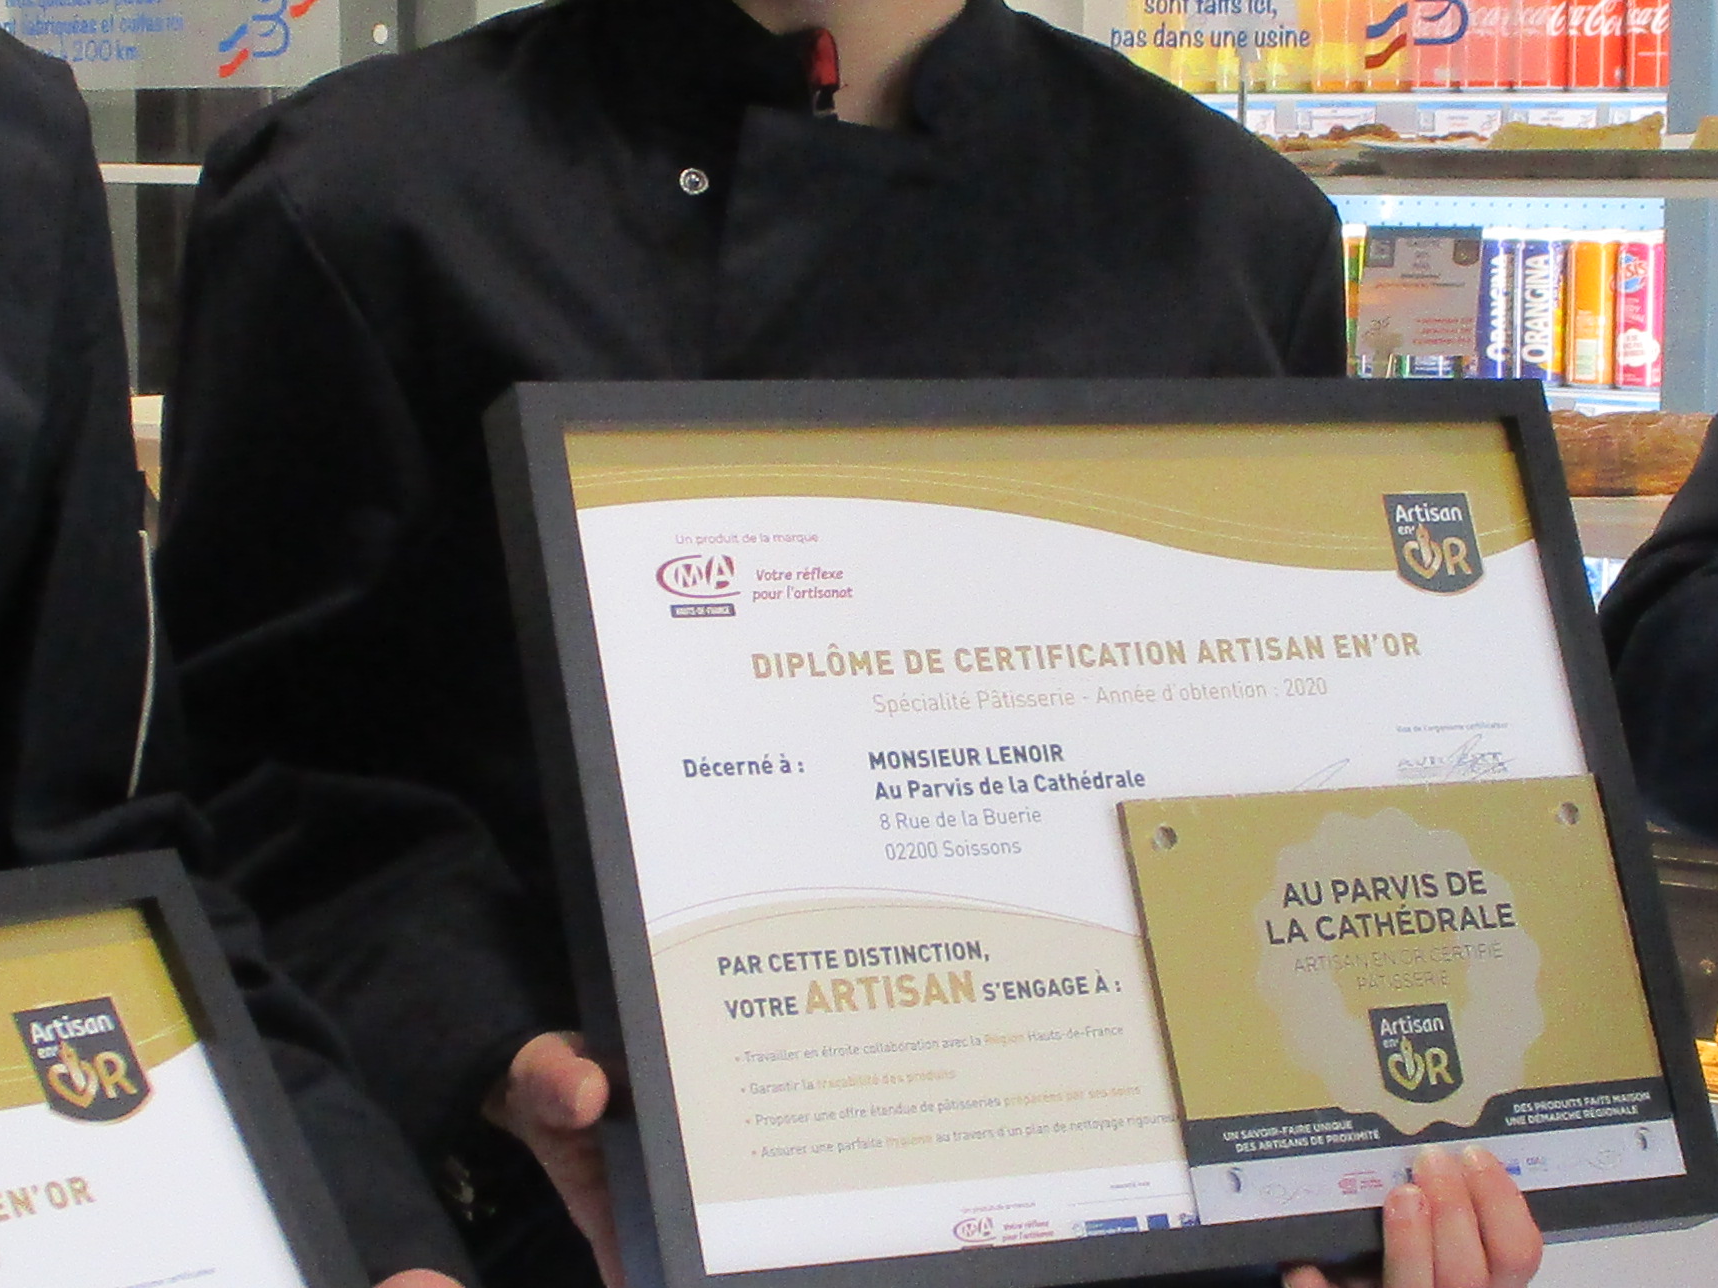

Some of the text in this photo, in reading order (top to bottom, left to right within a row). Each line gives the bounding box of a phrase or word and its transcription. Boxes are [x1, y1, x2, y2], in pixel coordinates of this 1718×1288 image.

[1110, 22, 1312, 49] pas dans une usine
[72, 39, 112, 62] 200
[1521, 253, 1552, 364] ORANGINA
[1394, 503, 1463, 524] Artisan
[755, 566, 843, 581] Votre réflexe
[751, 632, 1419, 679] DIPLÔME DE CERTIFICATION ARTISAN EN'OR
[871, 690, 971, 717] Spécialité
[975, 688, 1075, 709] Pâtisserie
[1096, 684, 1156, 704] Année
[1283, 676, 1327, 697] 2020
[682, 753, 791, 778] Décerné à
[868, 743, 1063, 769] MONSIEUR LENOIR
[875, 769, 1145, 800] Au Parvis de la Cathédrale
[879, 806, 1041, 830] 8 Rue de la Buerie
[884, 839, 1022, 861] 02200 Soissons
[1282, 869, 1488, 908] AU PARVIS DE
[1265, 902, 1516, 944] LA CATHÉDRALE
[717, 940, 989, 975] PAR CETTE DISTINCTION,
[724, 970, 1110, 1019] VOTRE ARTISAN S'ENGAGE À
[28, 1010, 116, 1046] Artisan
[1380, 1015, 1445, 1036] Artisan
